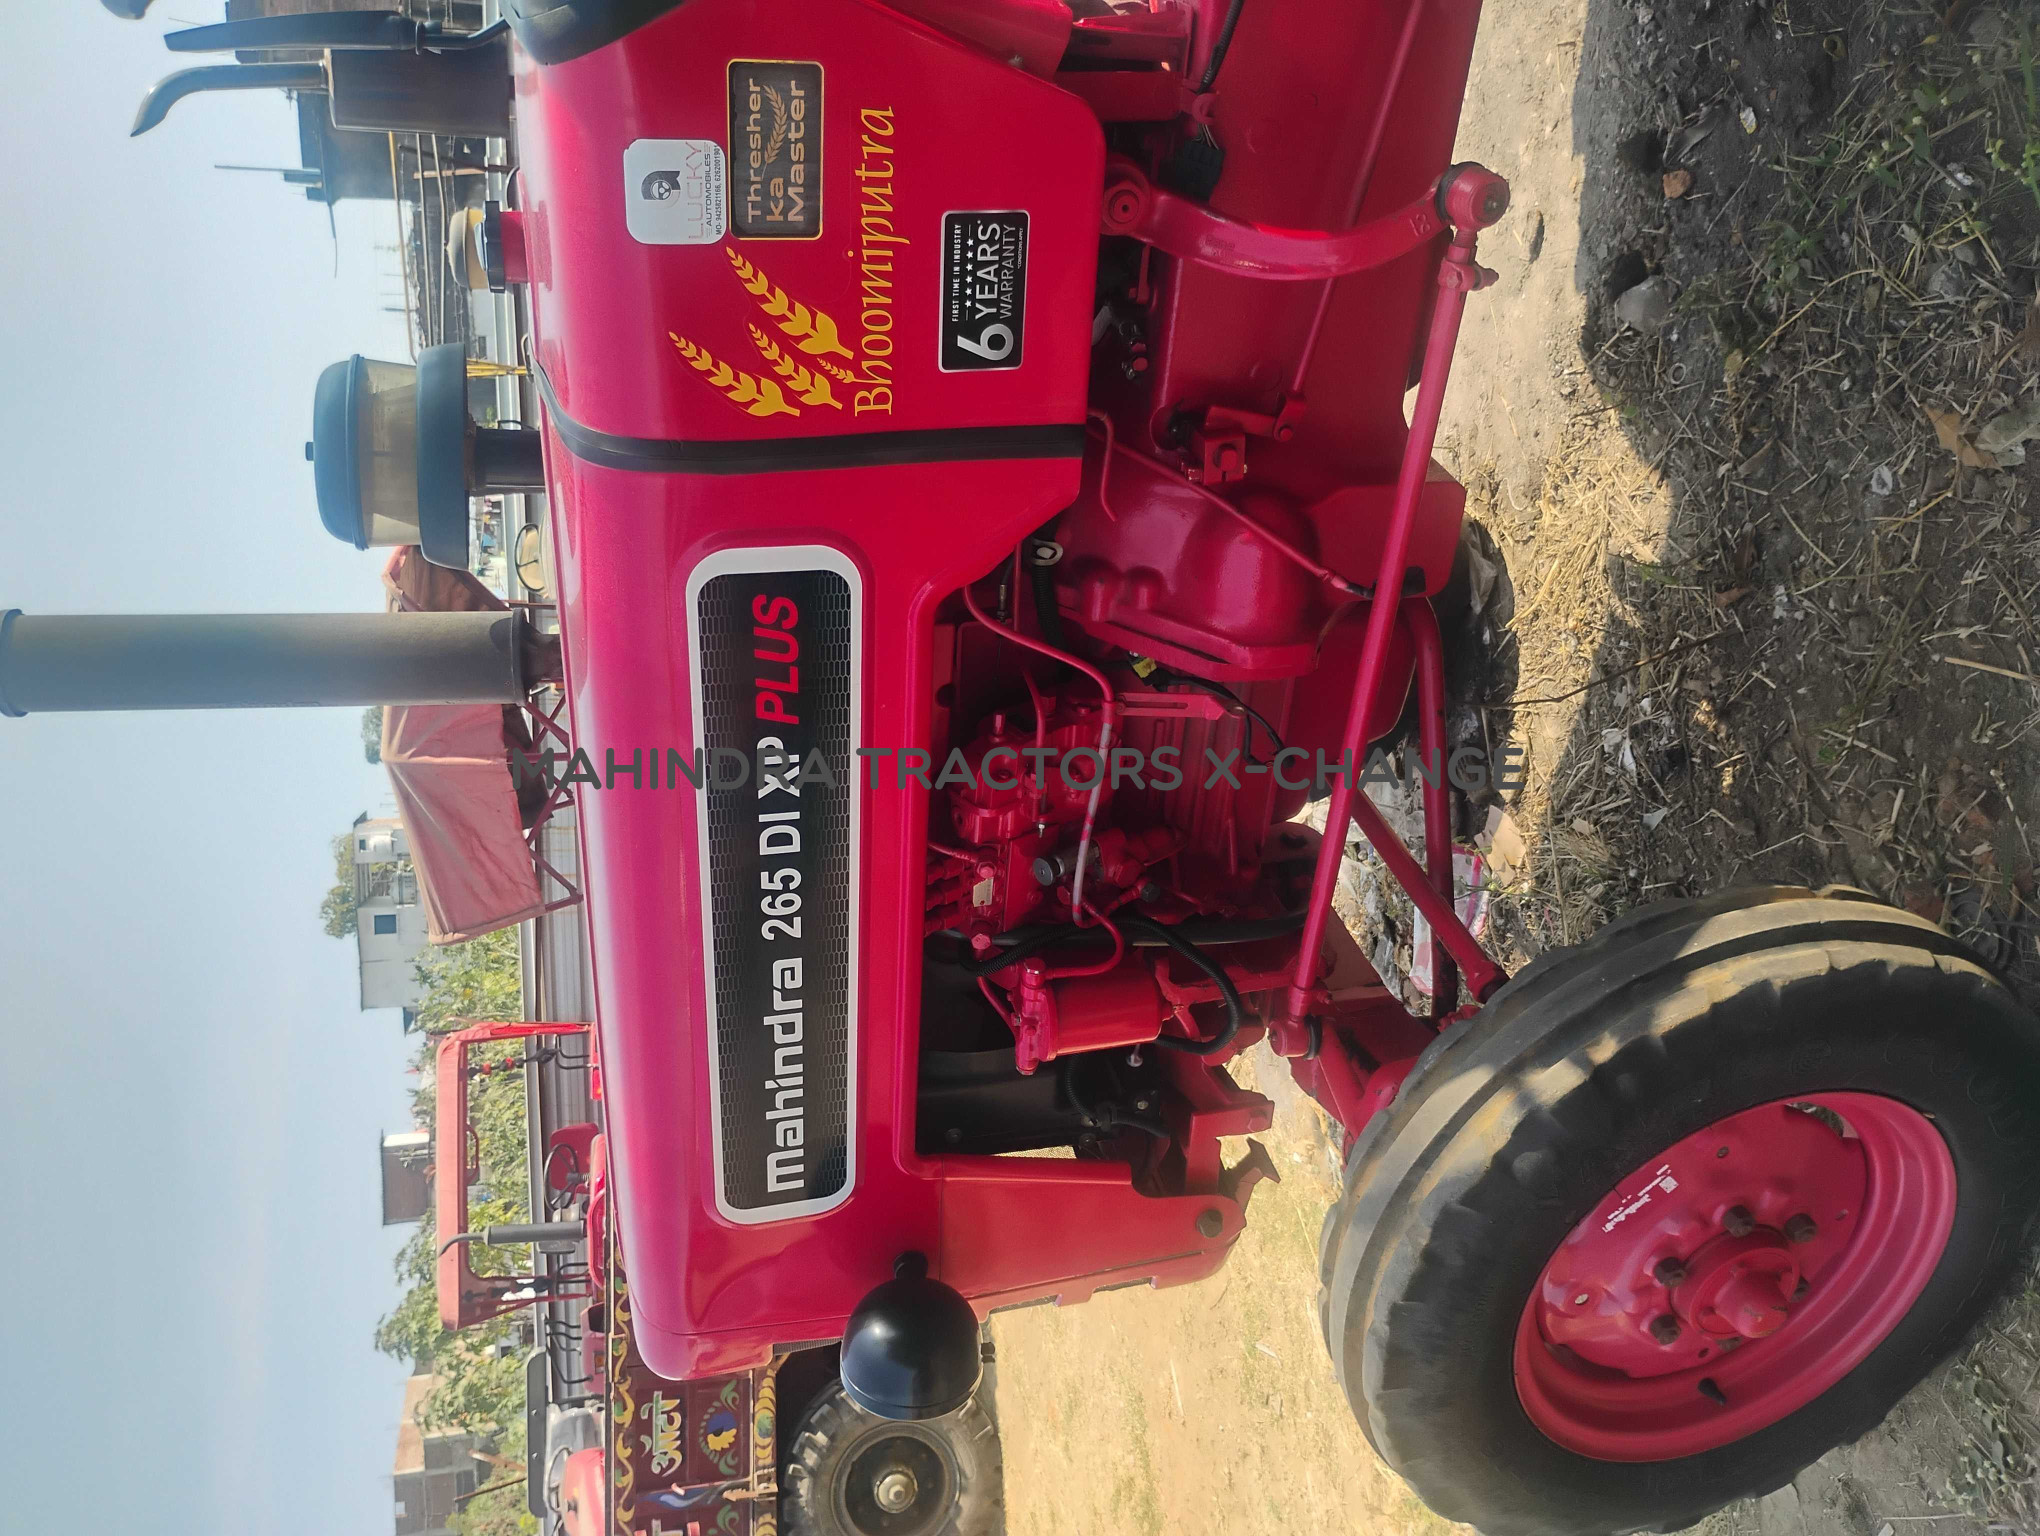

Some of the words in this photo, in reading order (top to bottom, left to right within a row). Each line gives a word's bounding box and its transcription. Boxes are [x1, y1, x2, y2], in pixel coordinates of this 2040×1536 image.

[747, 78, 762, 224] Thresher
[788, 80, 805, 222] Master
[686, 141, 704, 238] LUCKY
[766, 177, 784, 222] ka
[848, 105, 910, 416] Bhoomiputra
[953, 266, 960, 275] IN
[954, 224, 962, 263] INDUSTRY
[1000, 224, 1016, 319] WARRANTY
[957, 323, 1014, 361] 6
[752, 594, 799, 725] PLUS
[757, 736, 800, 799] XP
[758, 811, 800, 856] DI
[761, 867, 802, 941] 265
